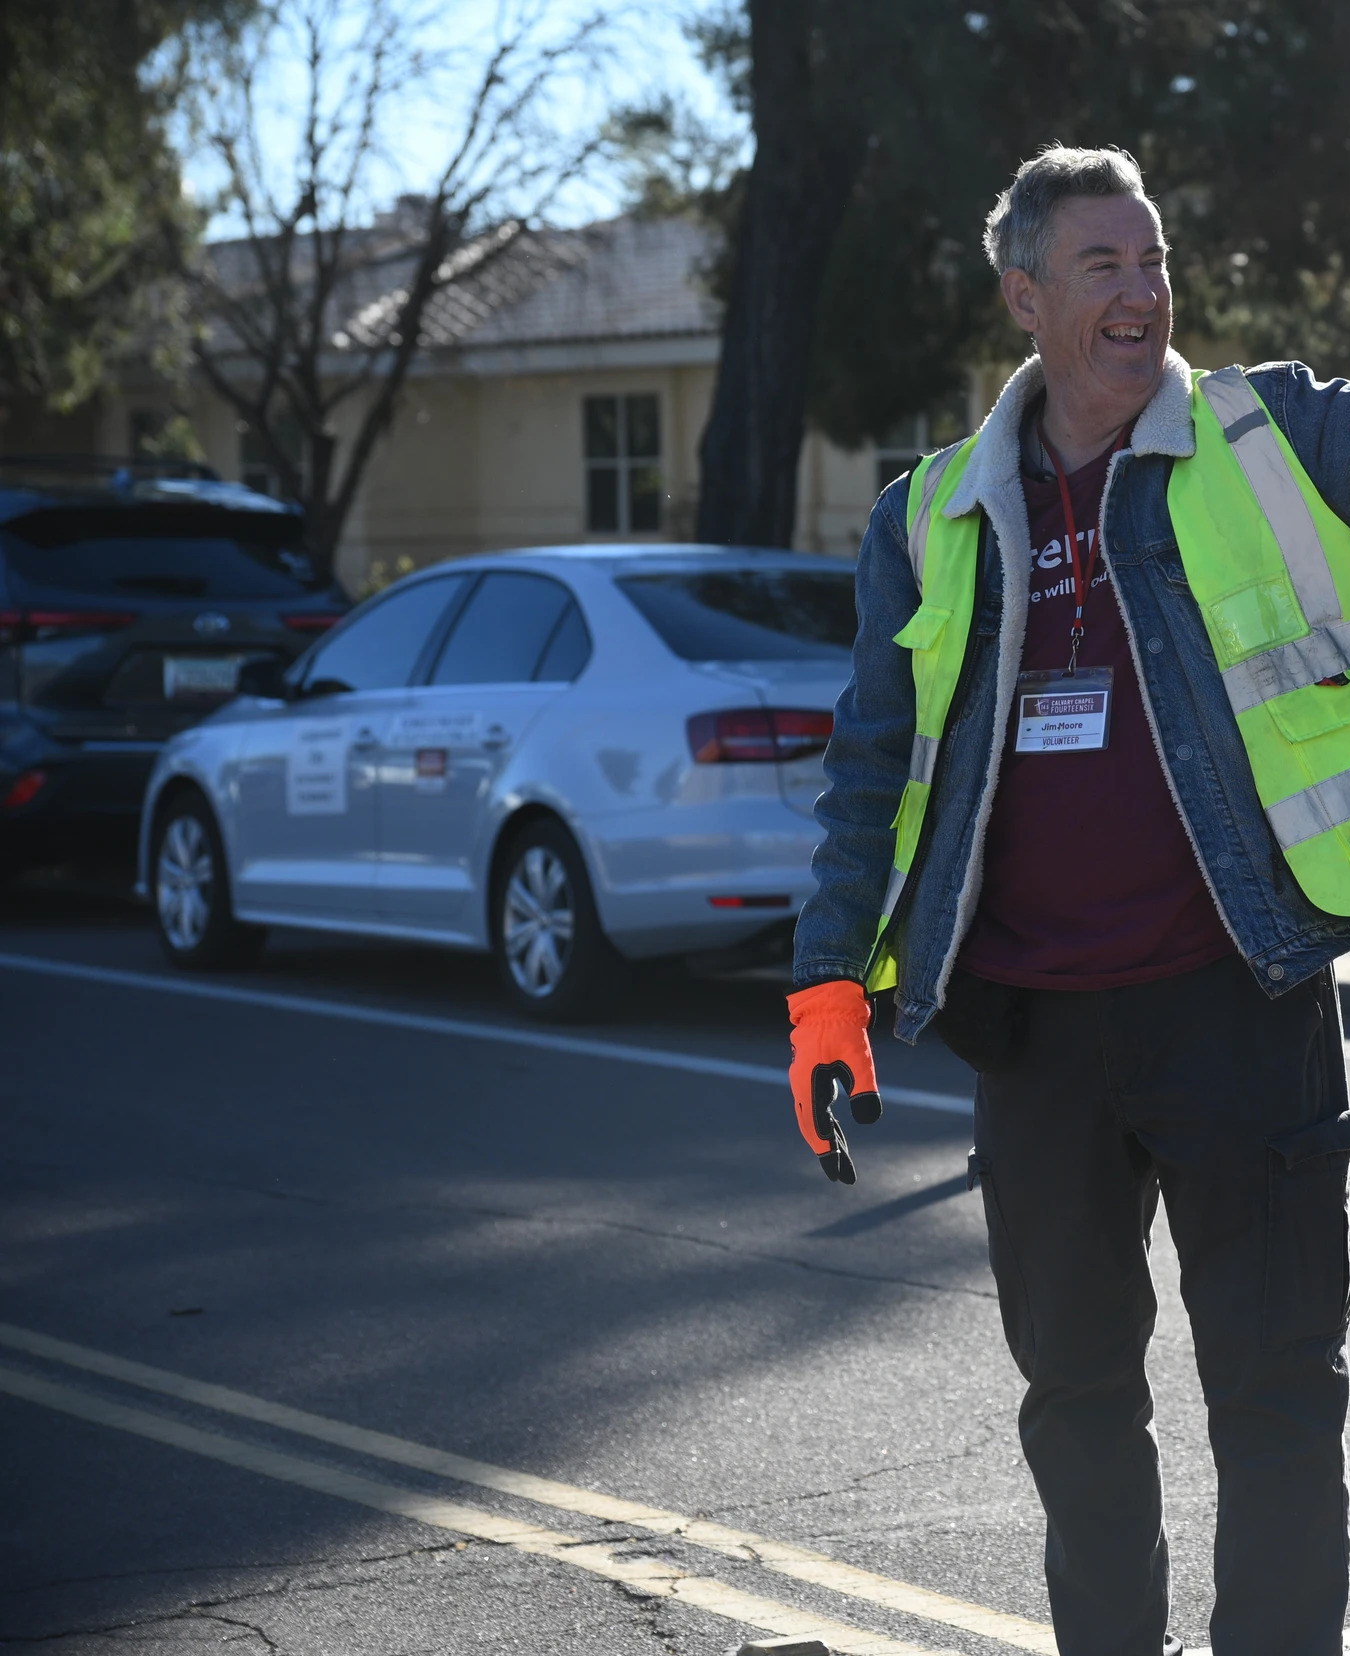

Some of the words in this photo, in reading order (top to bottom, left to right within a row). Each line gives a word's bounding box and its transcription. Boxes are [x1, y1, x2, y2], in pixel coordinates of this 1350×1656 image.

[1044, 577, 1076, 599] will
[1074, 697, 1095, 705] CHAPEL
[1050, 703, 1095, 714] FOURTEENSIX
[1041, 722, 1057, 731] Jim
[1058, 721, 1083, 730] Moore
[1042, 736, 1080, 746] VOLUNTEER
